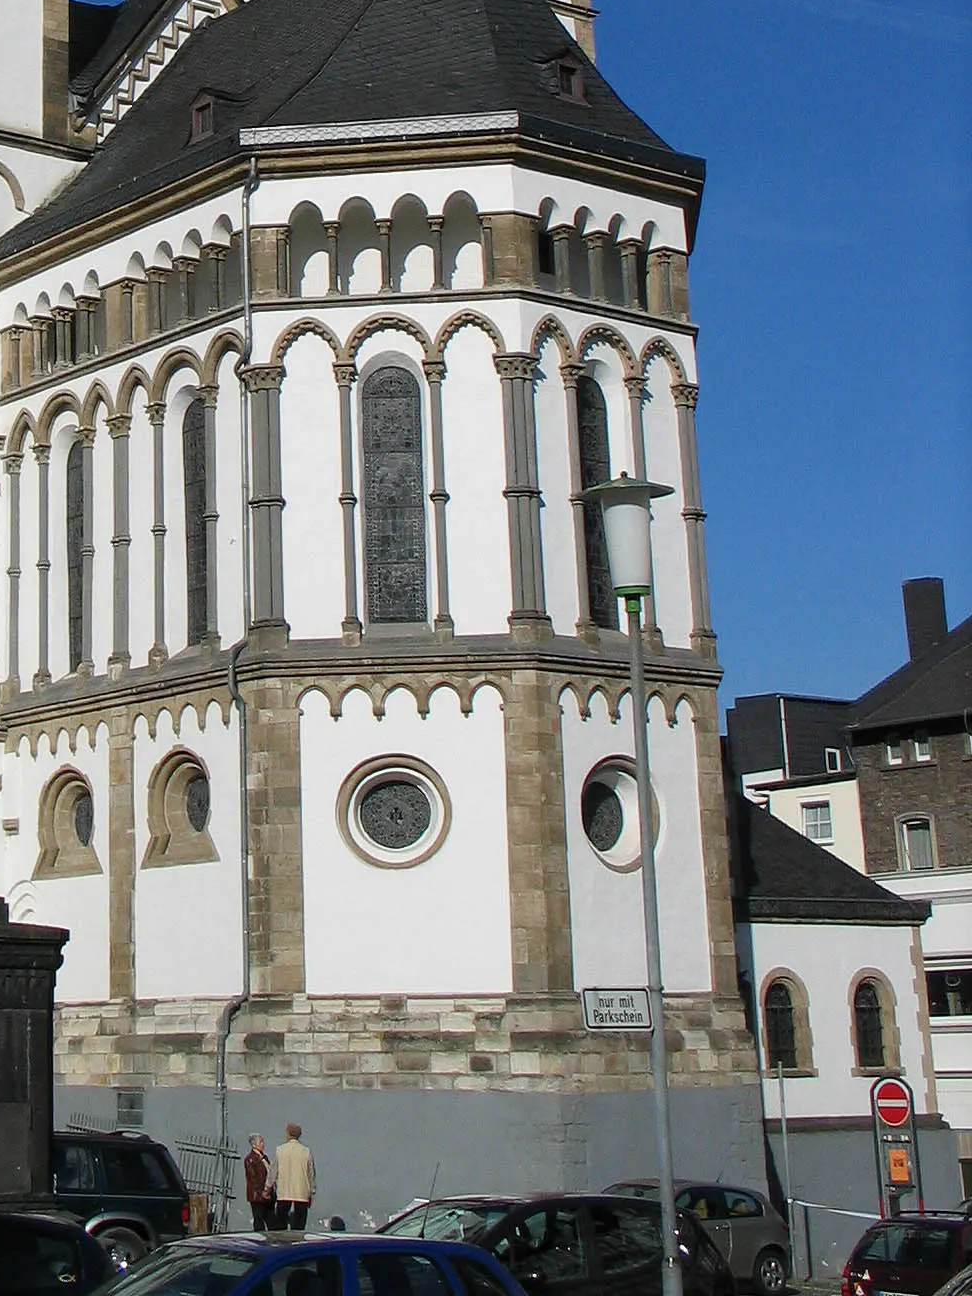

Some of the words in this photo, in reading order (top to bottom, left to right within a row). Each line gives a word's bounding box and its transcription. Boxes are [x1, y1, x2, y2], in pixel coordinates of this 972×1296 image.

[599, 998, 614, 1008] nur
[619, 994, 634, 1008] mit
[593, 1009, 644, 1023] Parkschein
